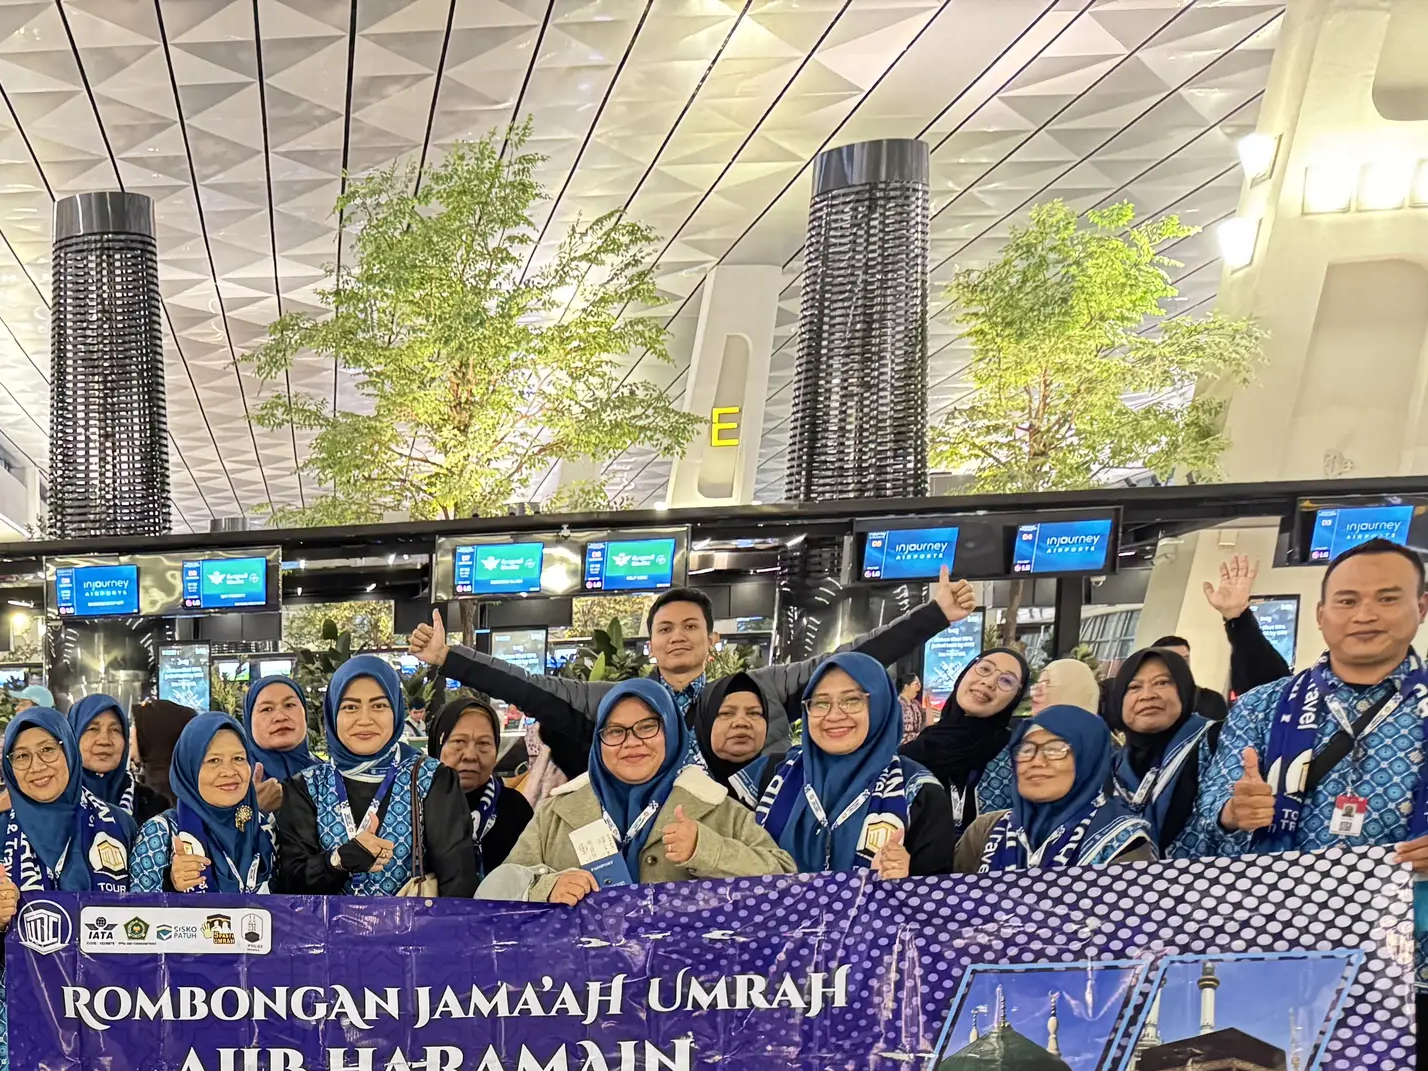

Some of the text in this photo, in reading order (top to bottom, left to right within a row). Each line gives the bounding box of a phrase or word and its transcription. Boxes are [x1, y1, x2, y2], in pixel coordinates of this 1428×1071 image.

[712, 407, 740, 446] E
[1046, 534, 1101, 547] injourney
[895, 542, 949, 553] injourney
[83, 579, 130, 590] injourney
[98, 883, 126, 894] TOUR
[88, 931, 114, 940] IATA
[62, 963, 849, 1031] ROMBONGAN JAMA'AH UMRAH
